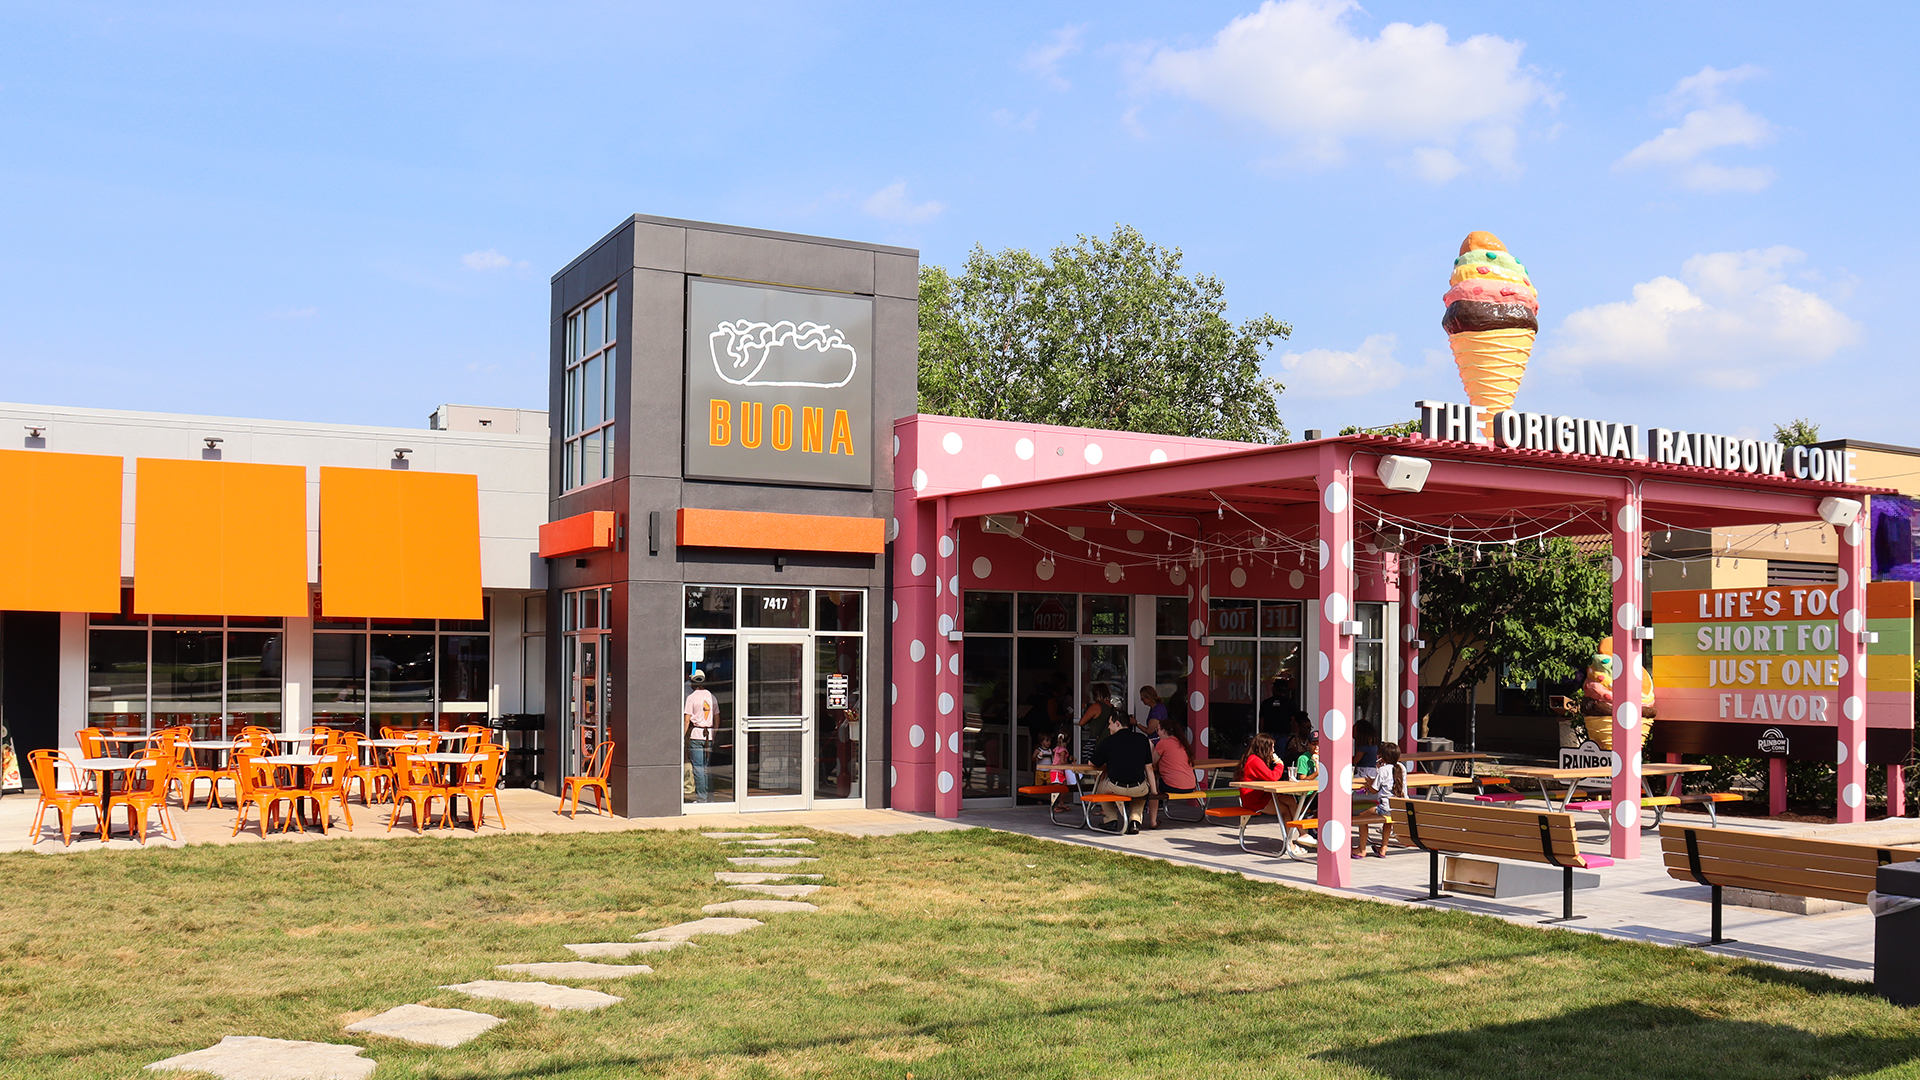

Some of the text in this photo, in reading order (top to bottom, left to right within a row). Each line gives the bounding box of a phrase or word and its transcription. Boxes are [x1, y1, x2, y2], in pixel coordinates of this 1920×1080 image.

[709, 399, 854, 455] BUONA
[1415, 400, 1857, 483] THE ORIGINAL RAINBOW CONE
[763, 597, 788, 610] 7417
[1699, 590, 1781, 618] LIFE'S
[1697, 625, 1838, 651] SHORT FO
[1709, 659, 1839, 687] JUST ONE
[1719, 693, 1828, 722] FLAVOR
[1758, 739, 1786, 749] RAINBOW
[1563, 754, 1612, 769] RAINBO
